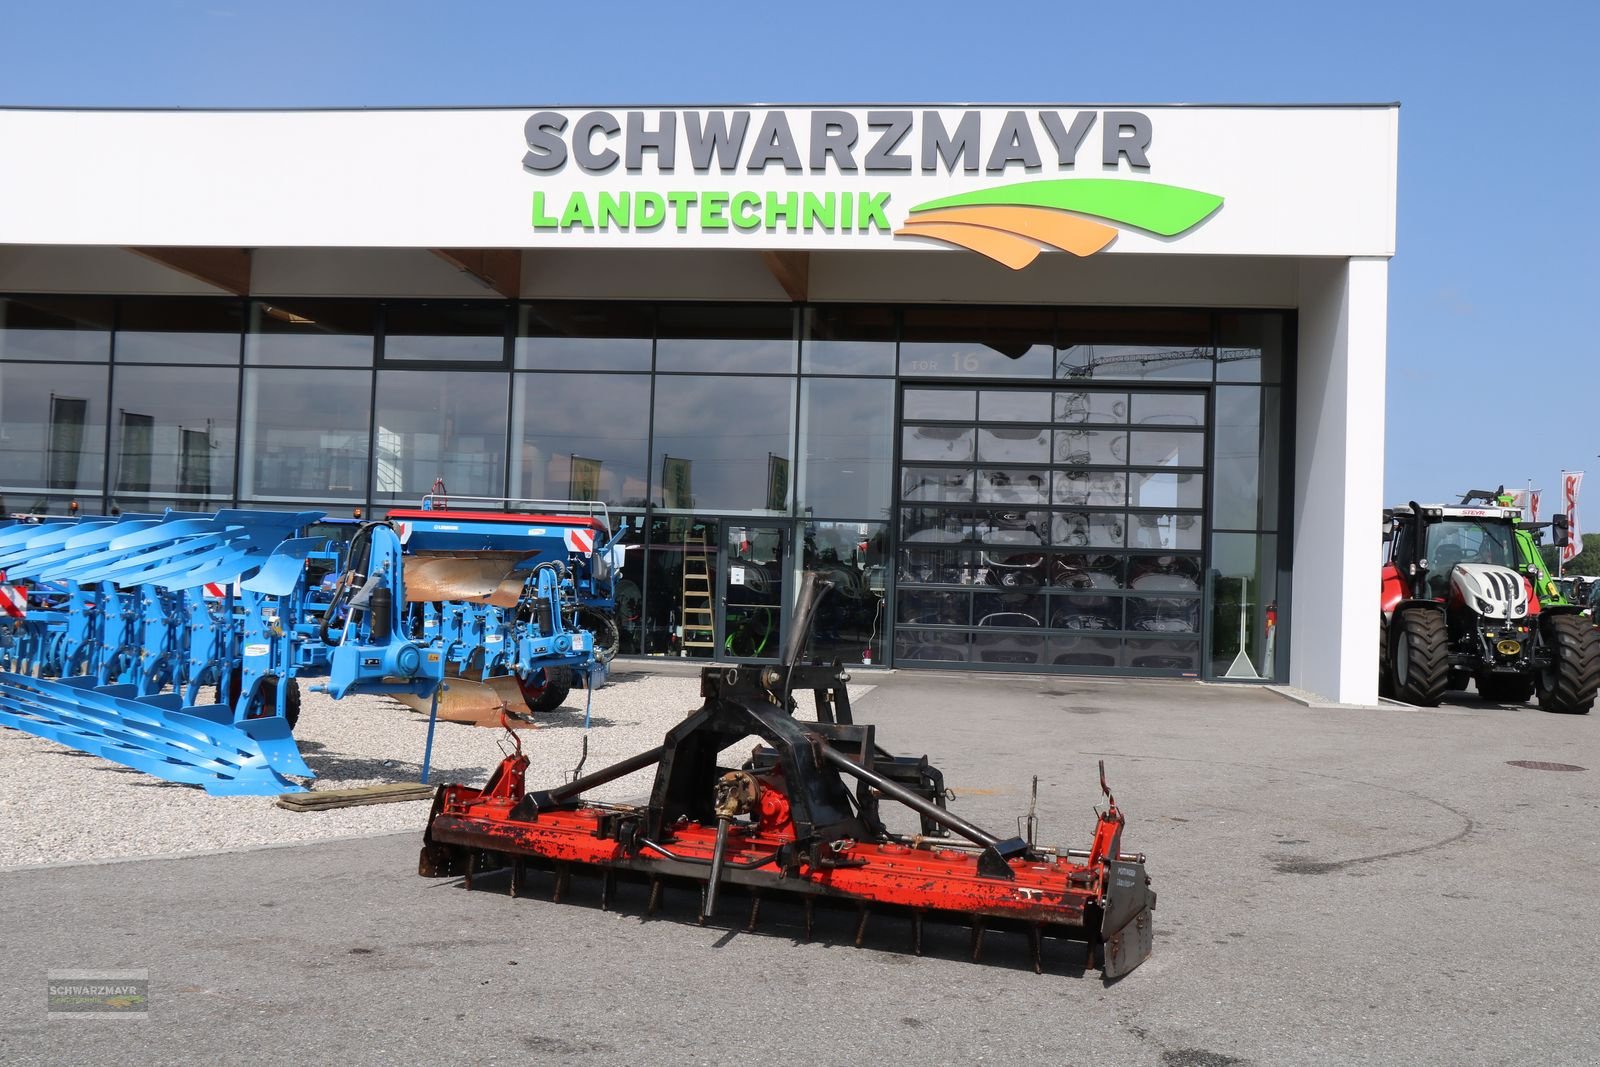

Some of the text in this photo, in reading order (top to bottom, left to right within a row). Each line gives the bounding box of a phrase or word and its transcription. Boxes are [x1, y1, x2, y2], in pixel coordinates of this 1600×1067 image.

[522, 110, 1152, 173] SCHWARZMAYR
[532, 191, 892, 231] LANDTECHNIK
[912, 352, 978, 372] TOR 16
